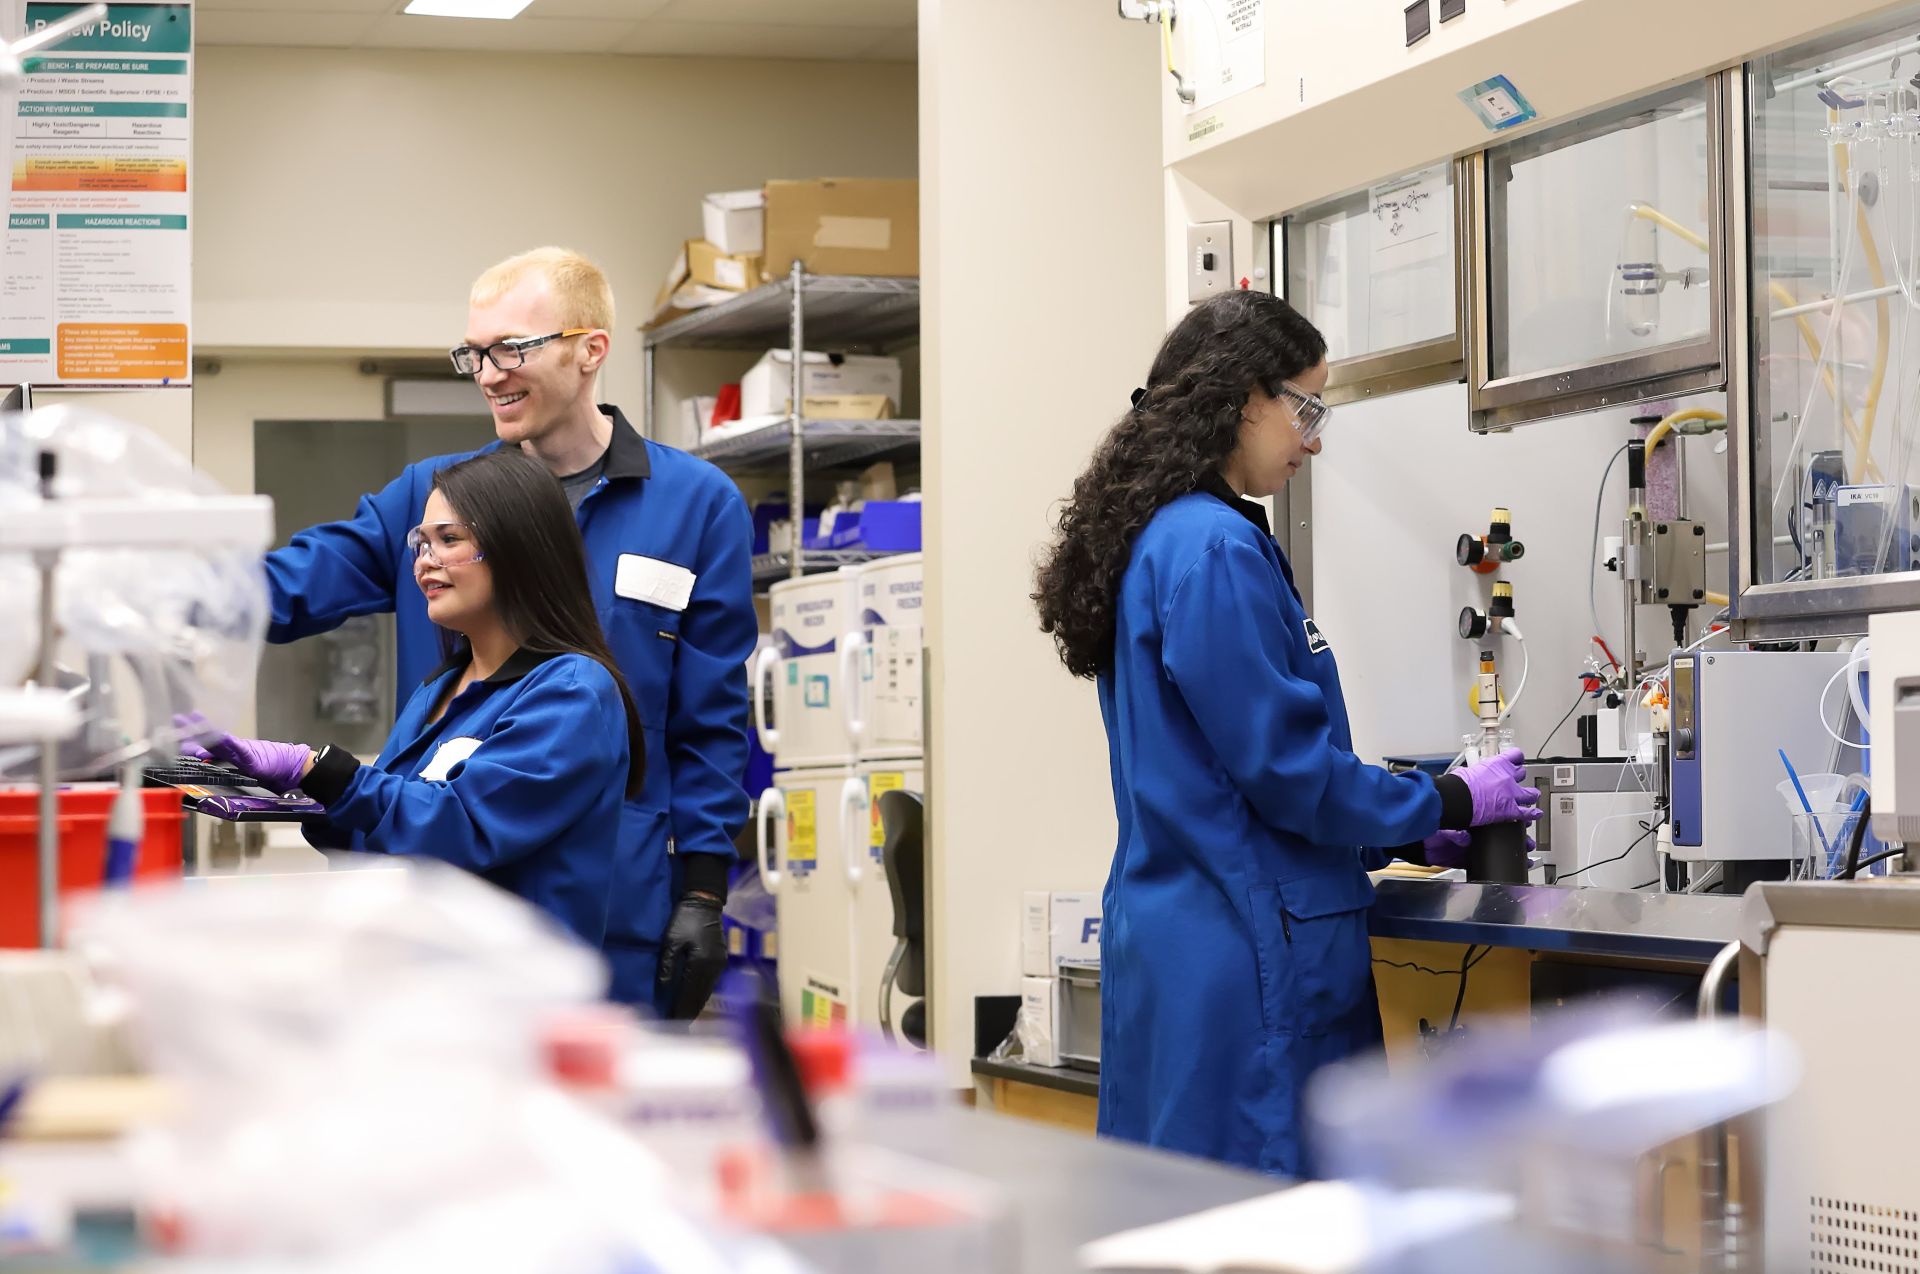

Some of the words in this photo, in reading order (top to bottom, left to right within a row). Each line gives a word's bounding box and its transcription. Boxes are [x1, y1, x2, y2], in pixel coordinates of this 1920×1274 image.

[100, 20, 151, 42] Policy
[45, 105, 70, 113] REVIEW
[71, 105, 94, 113] MATRIX
